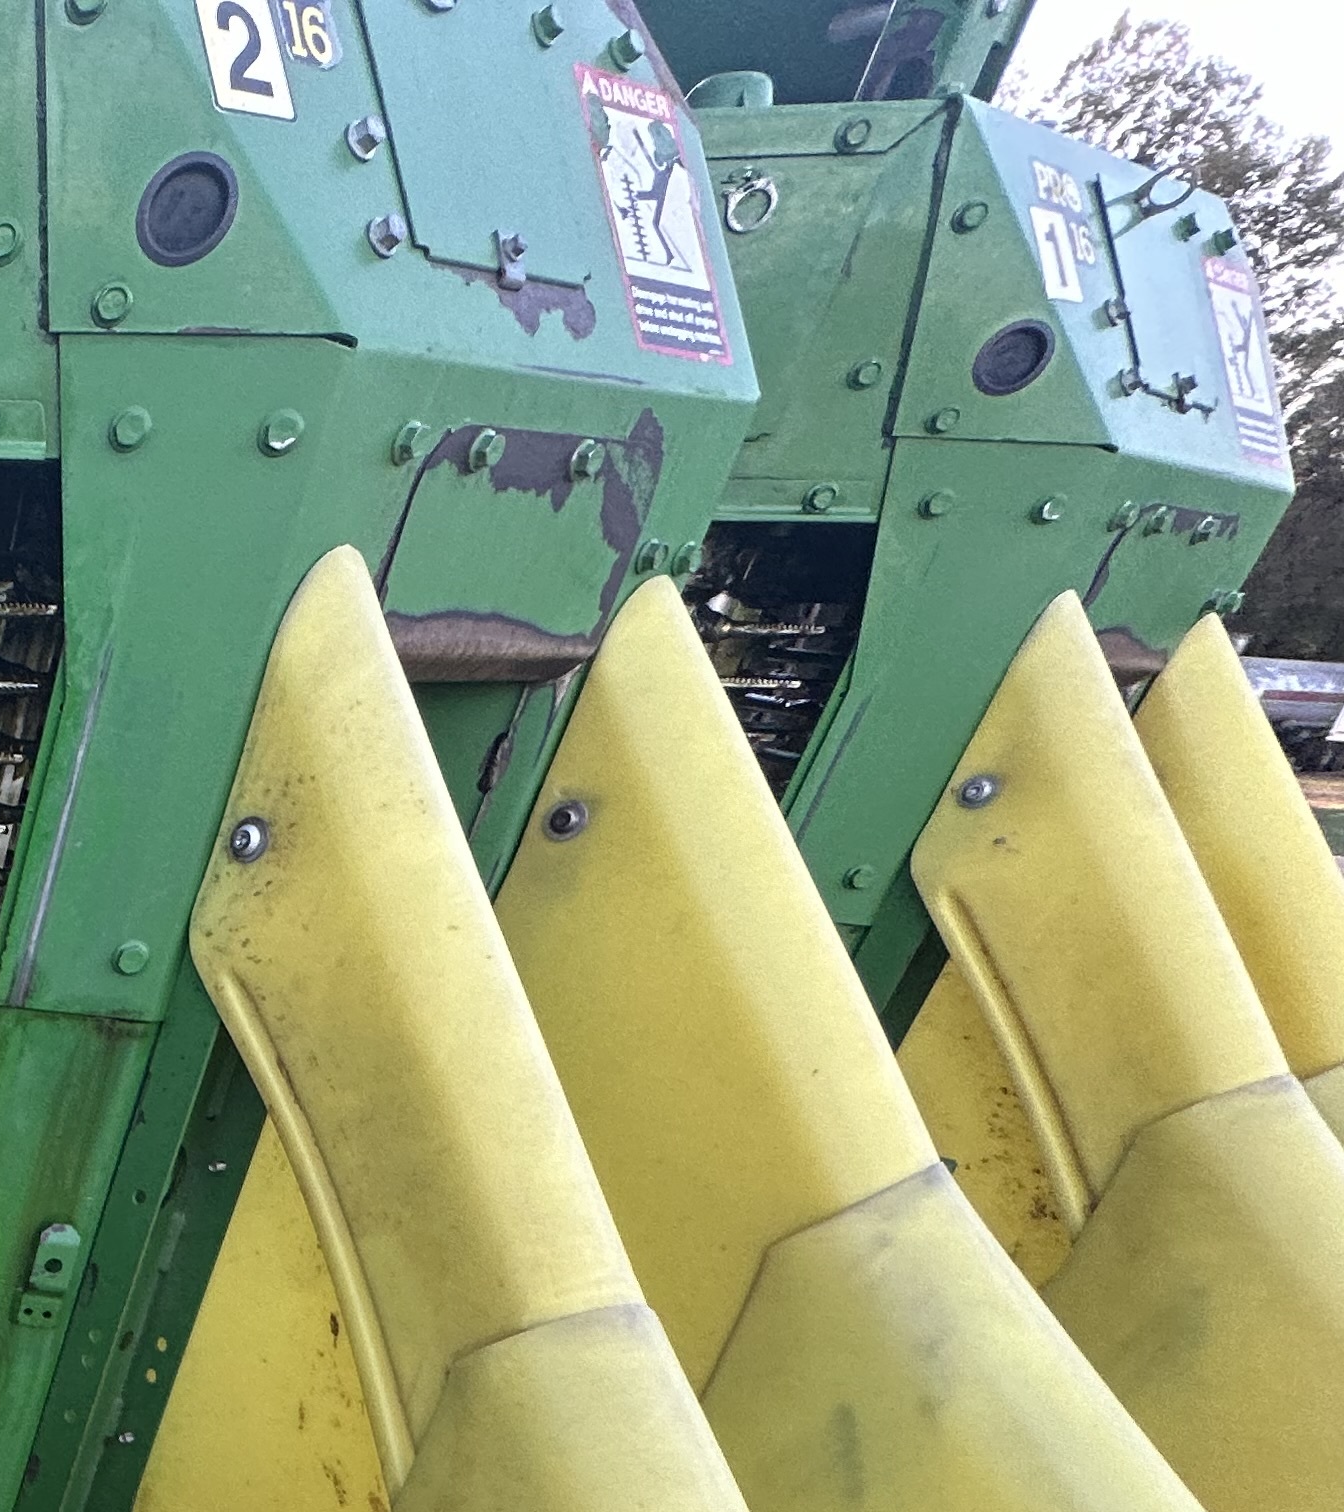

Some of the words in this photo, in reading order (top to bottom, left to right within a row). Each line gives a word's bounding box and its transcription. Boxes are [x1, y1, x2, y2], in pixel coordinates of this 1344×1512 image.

[216, 0, 275, 98] 2
[282, 0, 333, 66] 16
[598, 77, 671, 119] DANGER
[1044, 222, 1069, 288] 1
[1068, 221, 1096, 265] 16
